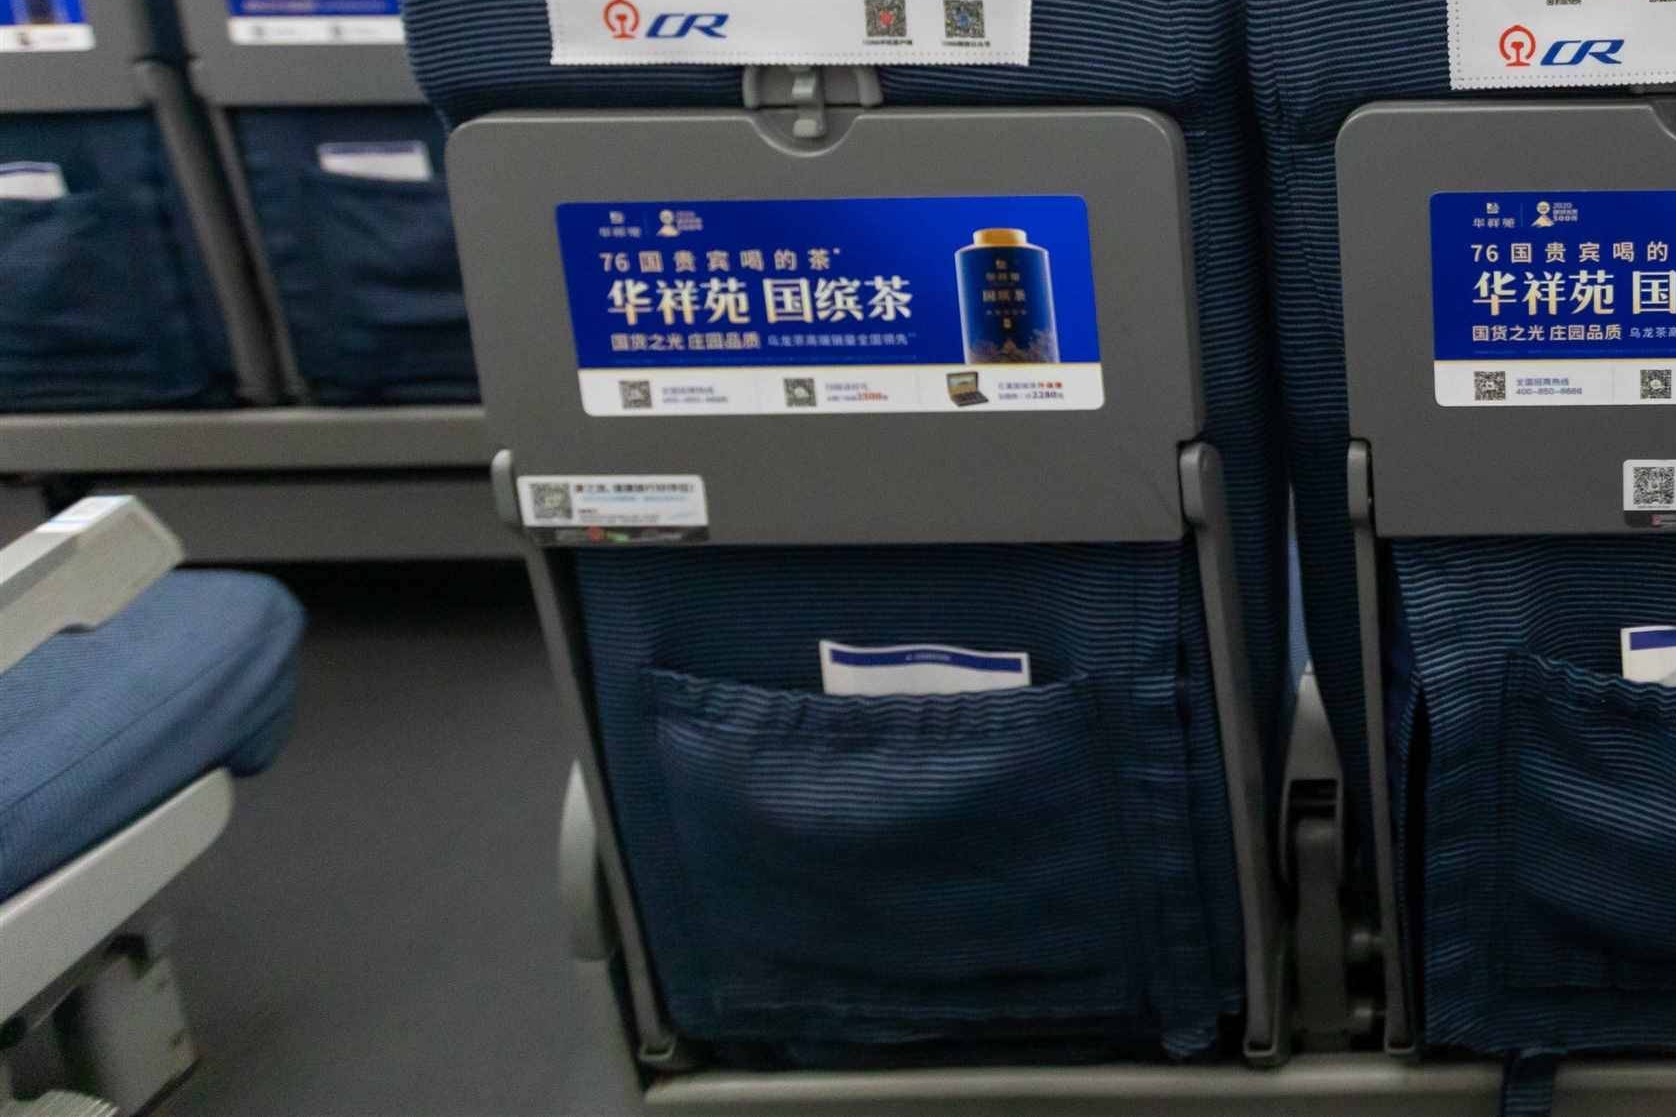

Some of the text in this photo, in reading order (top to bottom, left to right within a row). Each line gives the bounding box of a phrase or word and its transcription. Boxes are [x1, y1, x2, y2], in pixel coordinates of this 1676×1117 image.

[1540, 38, 1625, 66] CR
[607, 275, 913, 325] 华祥苑 国缤茶
[1472, 269, 1615, 317] 华祥苑
[1472, 324, 1545, 342] 国货之光
[1549, 324, 1622, 341] 庄园品质
